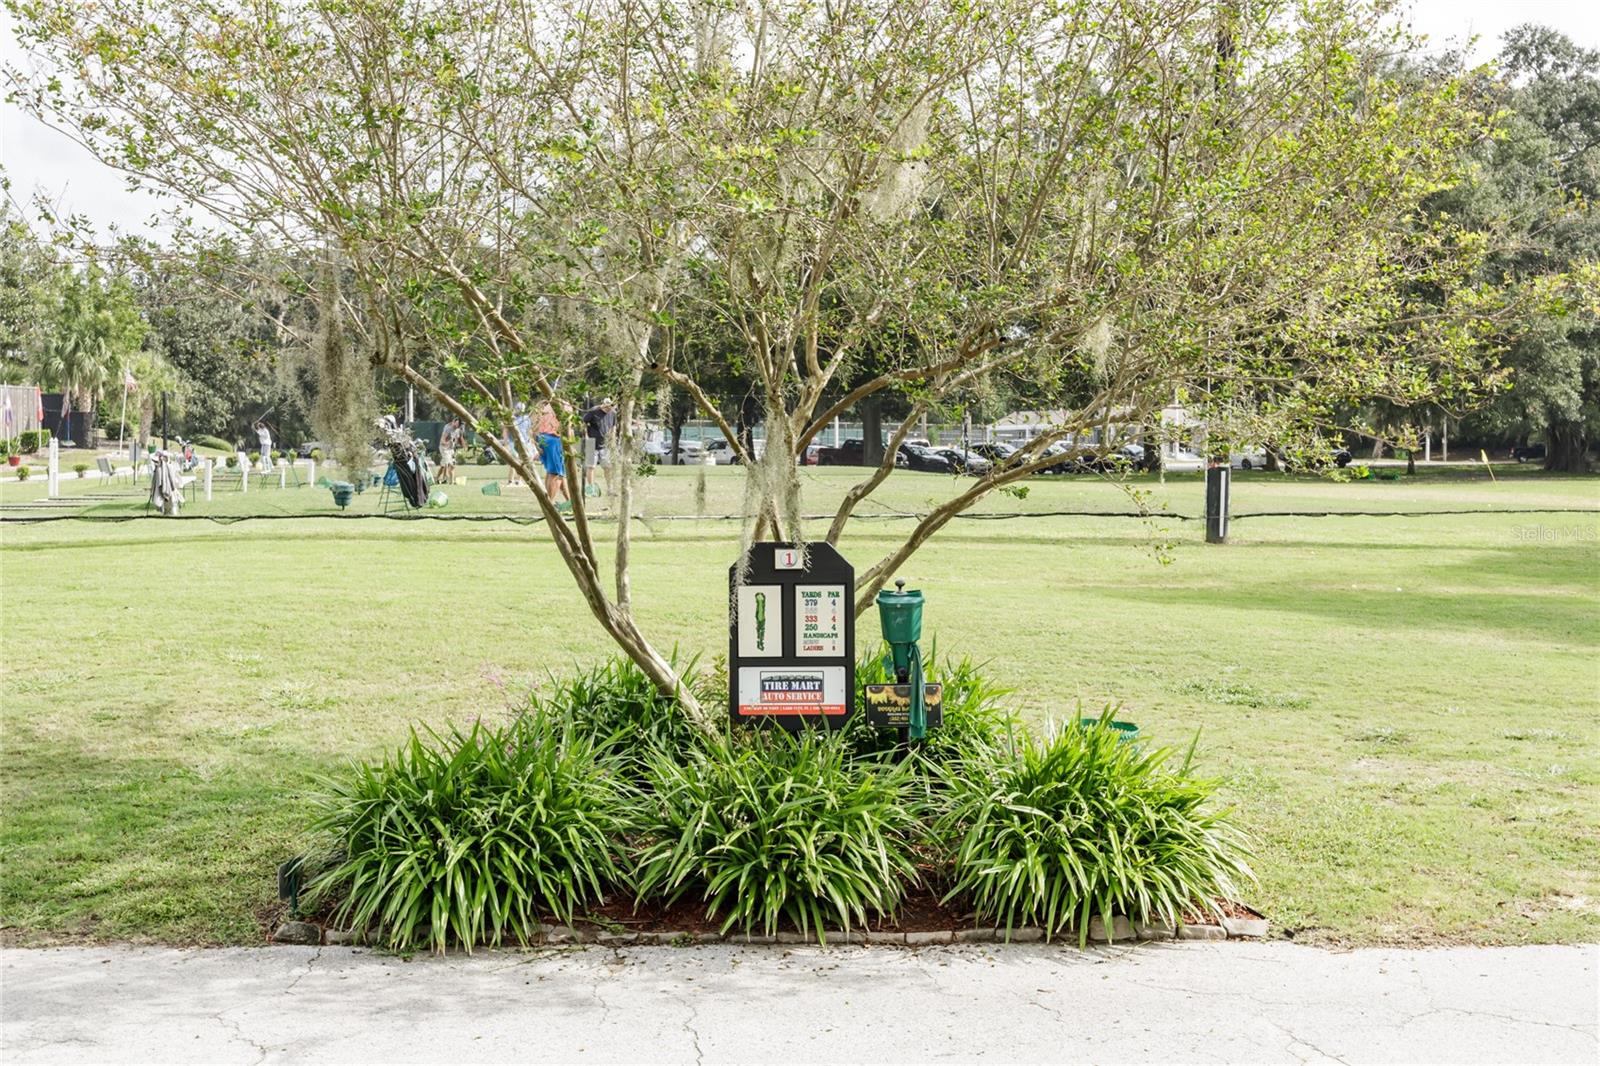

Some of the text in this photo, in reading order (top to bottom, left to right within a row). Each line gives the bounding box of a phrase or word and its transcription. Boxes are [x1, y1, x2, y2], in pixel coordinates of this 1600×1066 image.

[785, 552, 793, 565] 1
[763, 681, 820, 690] TIRE MART
[763, 692, 822, 701] AUTO SERVICE
